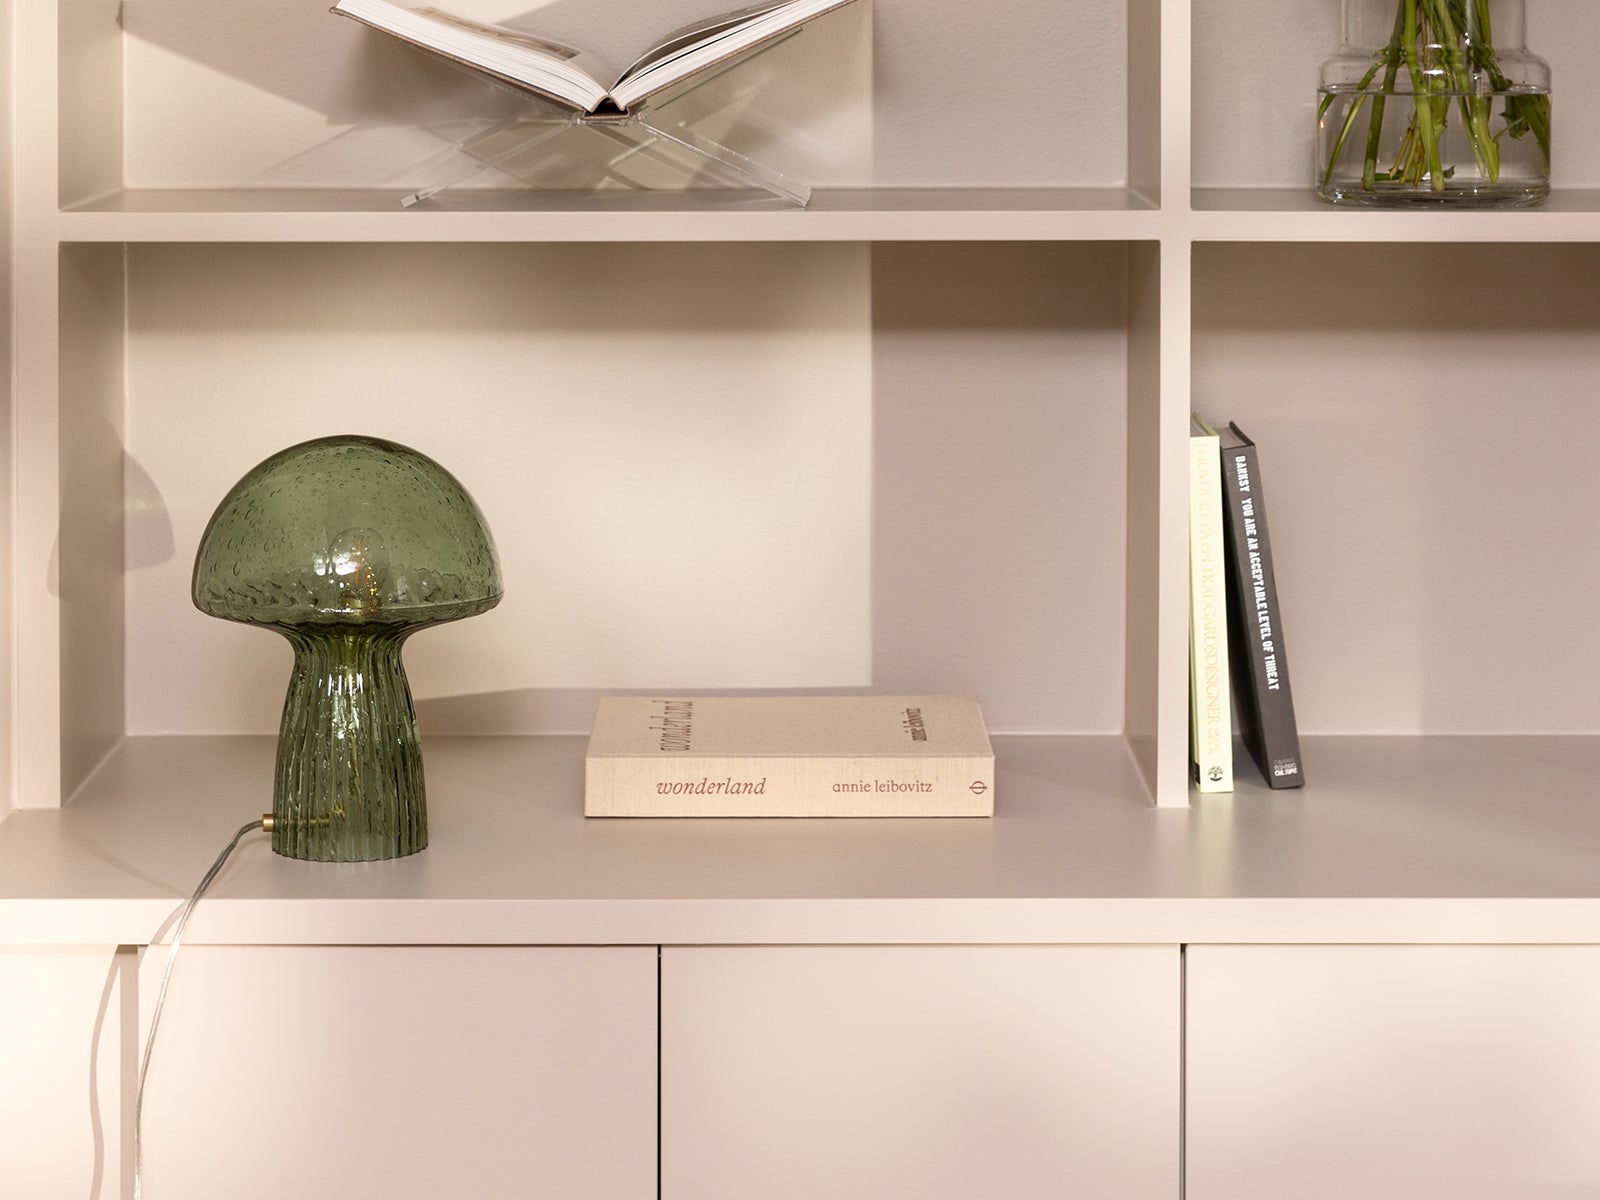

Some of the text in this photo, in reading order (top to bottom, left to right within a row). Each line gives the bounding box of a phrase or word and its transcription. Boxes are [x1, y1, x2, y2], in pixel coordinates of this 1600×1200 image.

[1235, 455, 1279, 690] BANKSY YOU ARE AN ACCEPTABLE LEVEL OF THREAT
[656, 777, 933, 795] wonderland annie leibovitz
